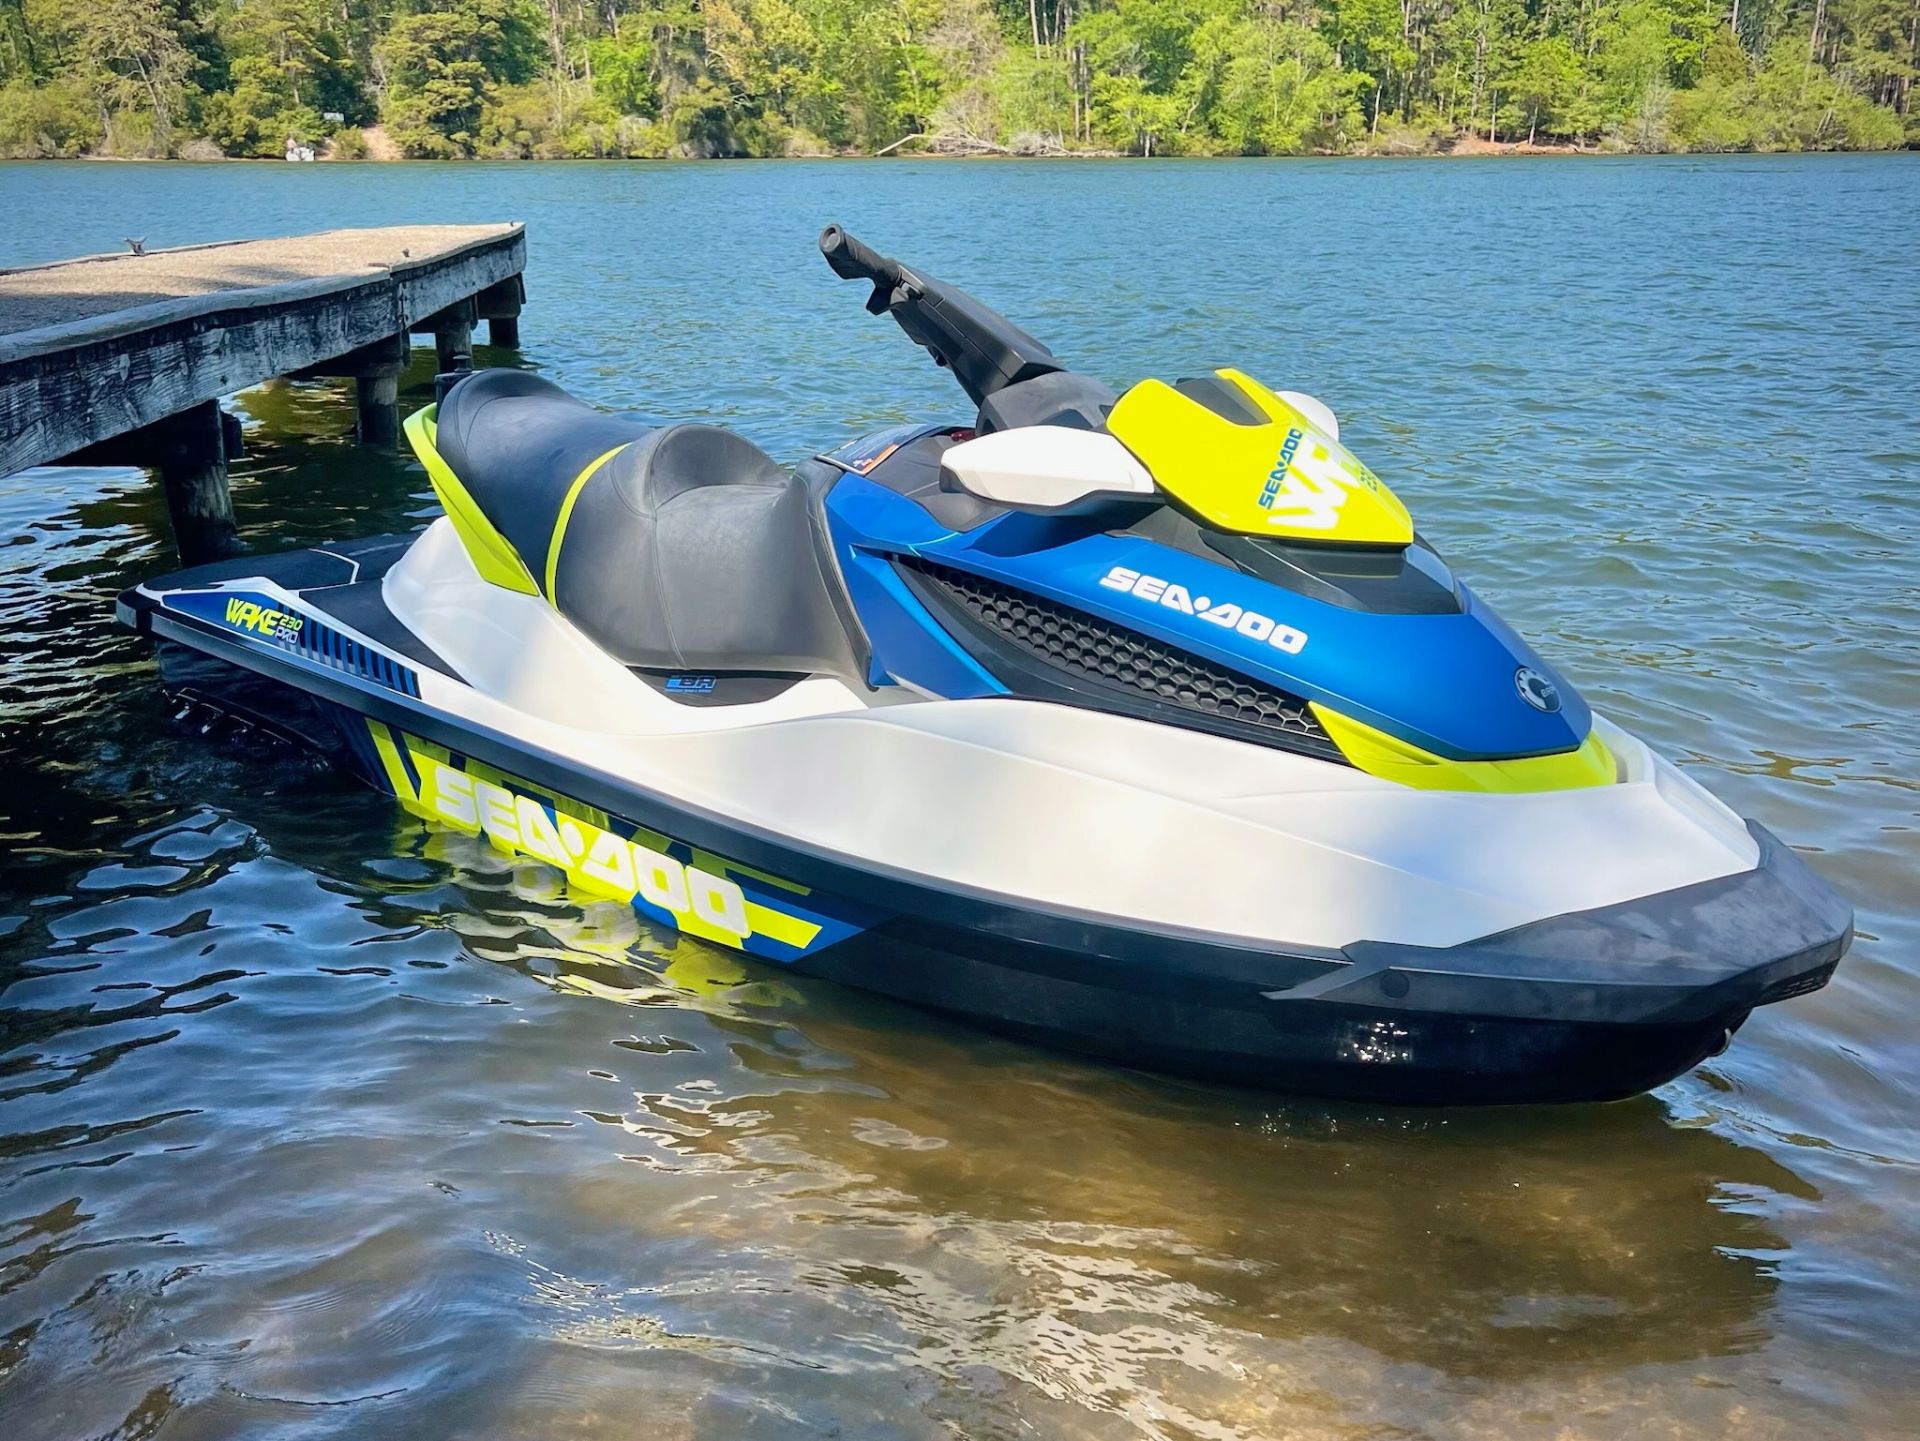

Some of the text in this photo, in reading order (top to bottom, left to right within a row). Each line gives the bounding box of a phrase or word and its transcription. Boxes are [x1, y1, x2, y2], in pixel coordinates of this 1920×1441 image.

[225, 597, 284, 636] WAKE
[279, 613, 304, 631] 230
[274, 625, 299, 643] PRO
